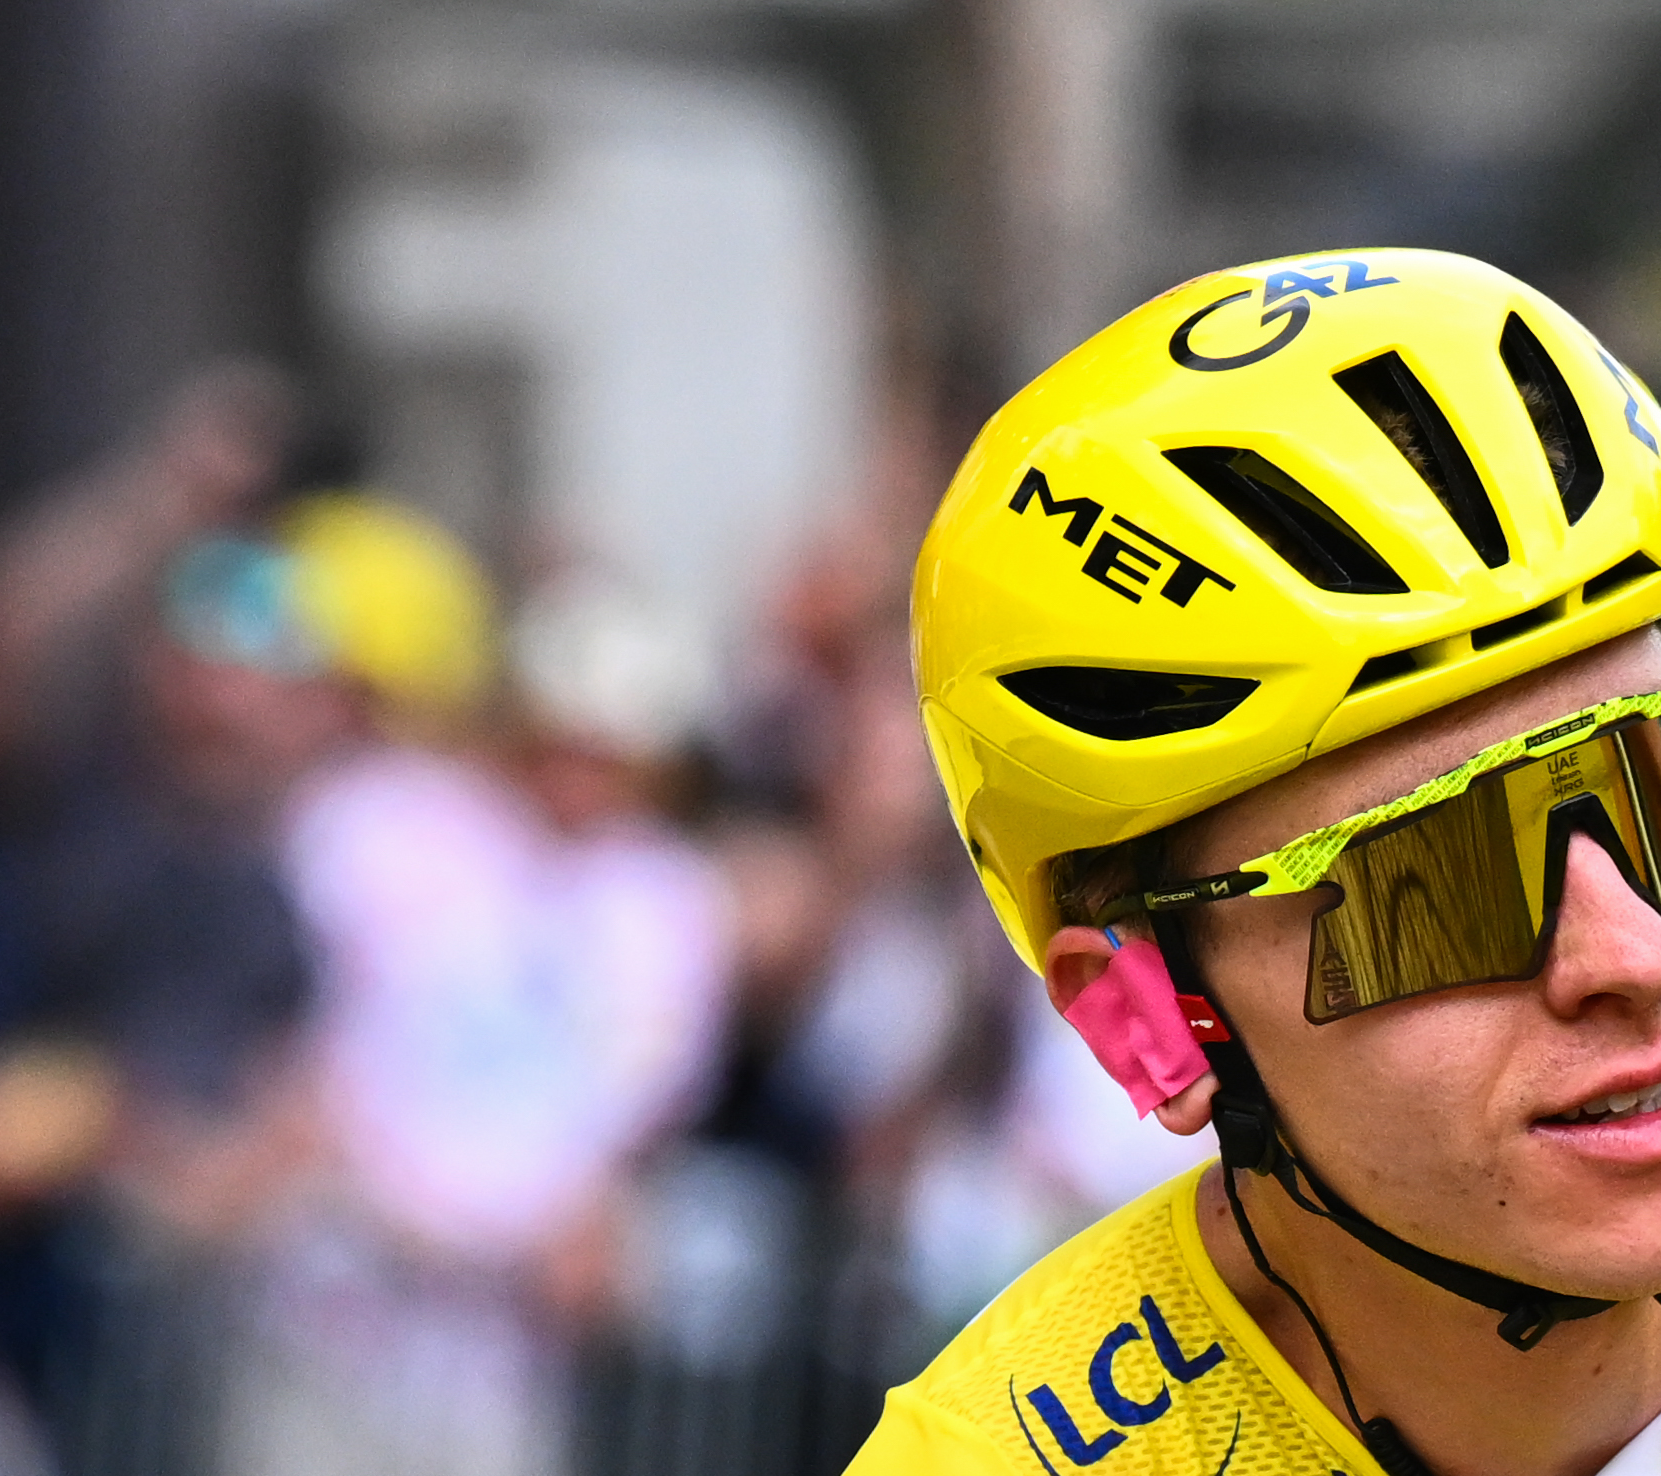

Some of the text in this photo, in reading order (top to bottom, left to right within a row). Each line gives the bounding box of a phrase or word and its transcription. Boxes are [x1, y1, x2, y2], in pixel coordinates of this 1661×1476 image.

[1007, 467, 1235, 608] MET
[1547, 752, 1580, 775] UAE
[1026, 1294, 1225, 1467] LCL
